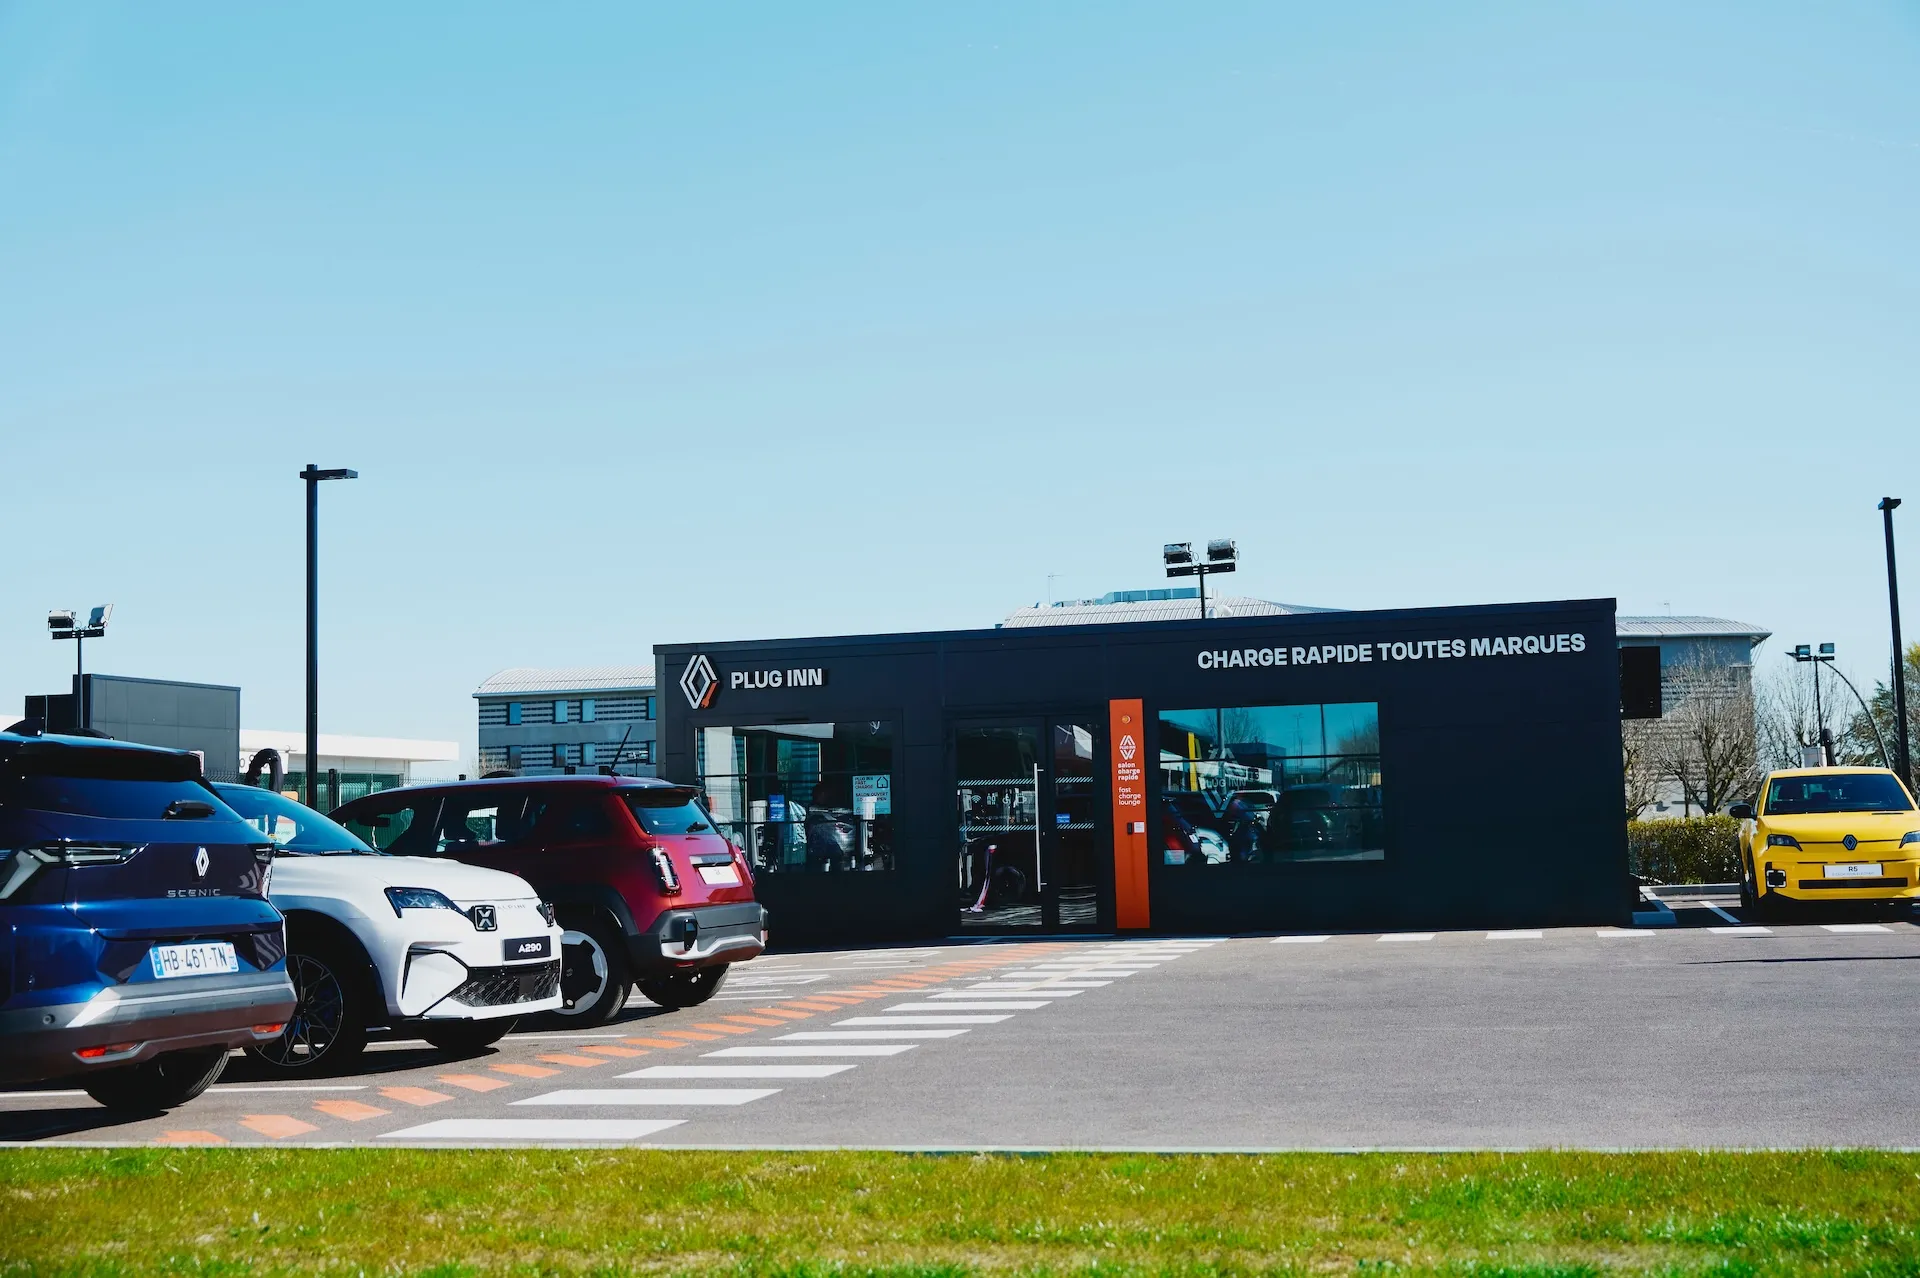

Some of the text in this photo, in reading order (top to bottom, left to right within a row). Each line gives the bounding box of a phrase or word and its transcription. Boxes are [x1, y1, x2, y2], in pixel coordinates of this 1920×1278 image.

[1197, 633, 1586, 669] CHARGE RAPIDE TOUTES MARQUES
[731, 668, 823, 689] PLUG INN
[167, 888, 221, 898] SCENIC
[518, 943, 542, 953] A290
